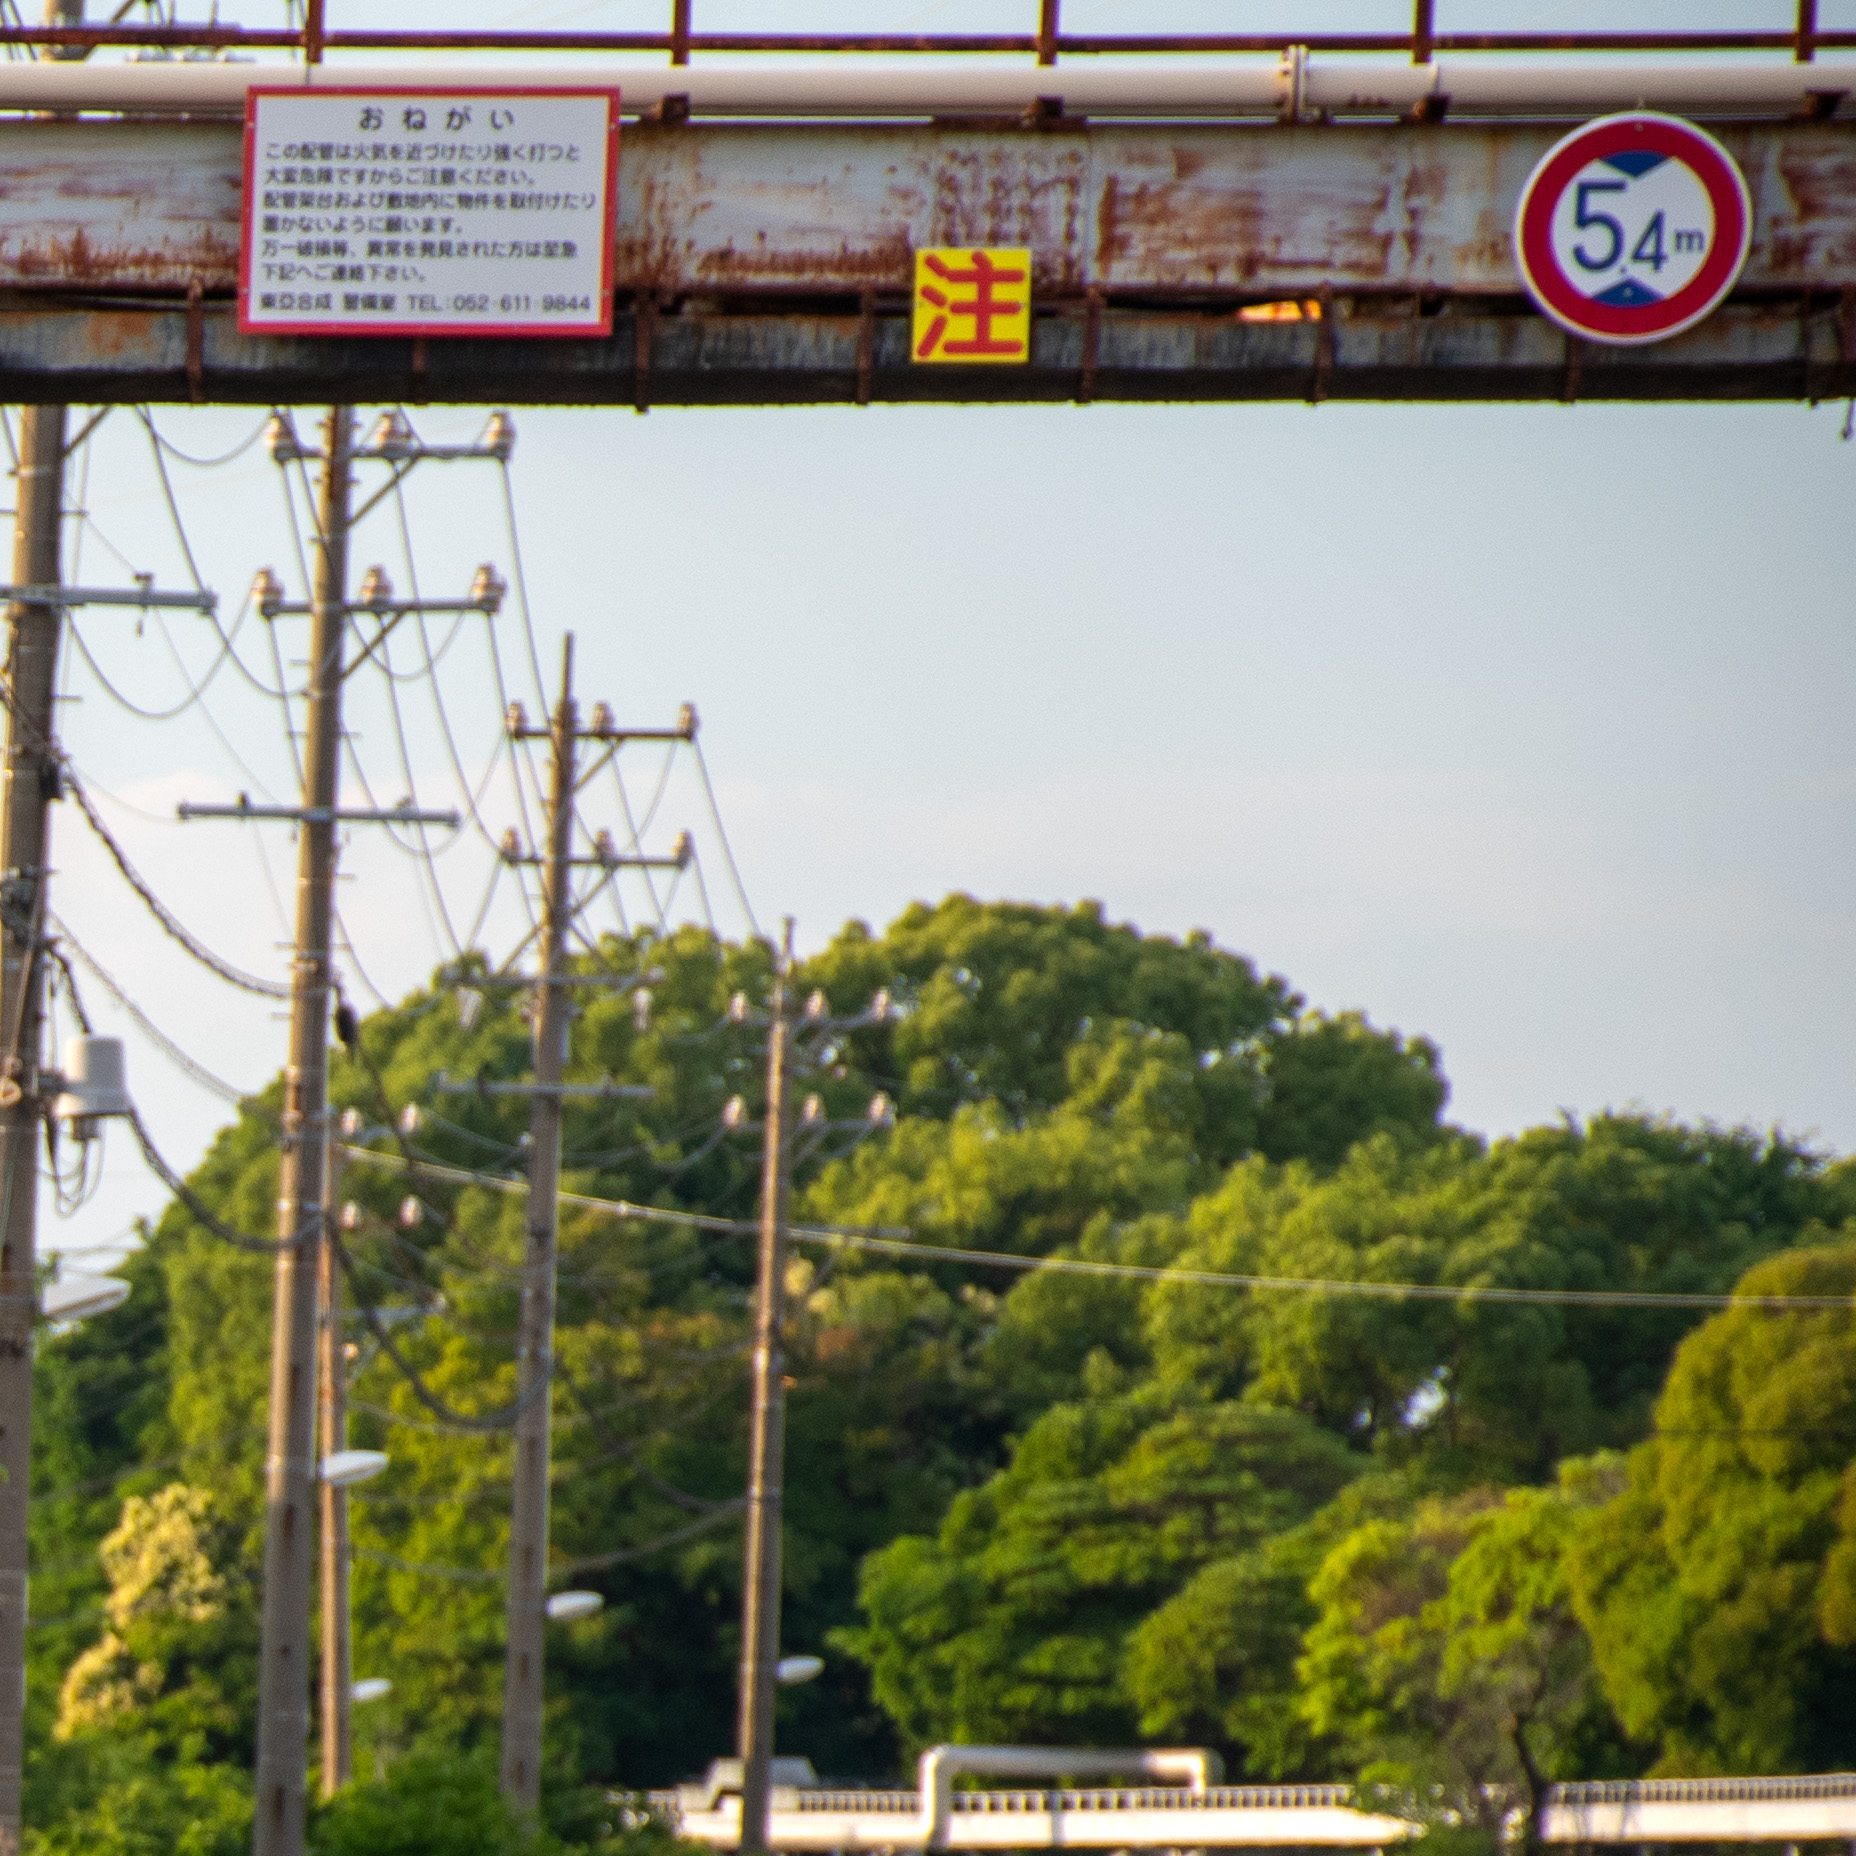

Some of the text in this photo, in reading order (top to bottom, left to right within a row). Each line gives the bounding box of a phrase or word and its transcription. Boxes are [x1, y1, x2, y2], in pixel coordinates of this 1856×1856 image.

[359, 106, 514, 132] おねがい
[917, 250, 1025, 357] 注
